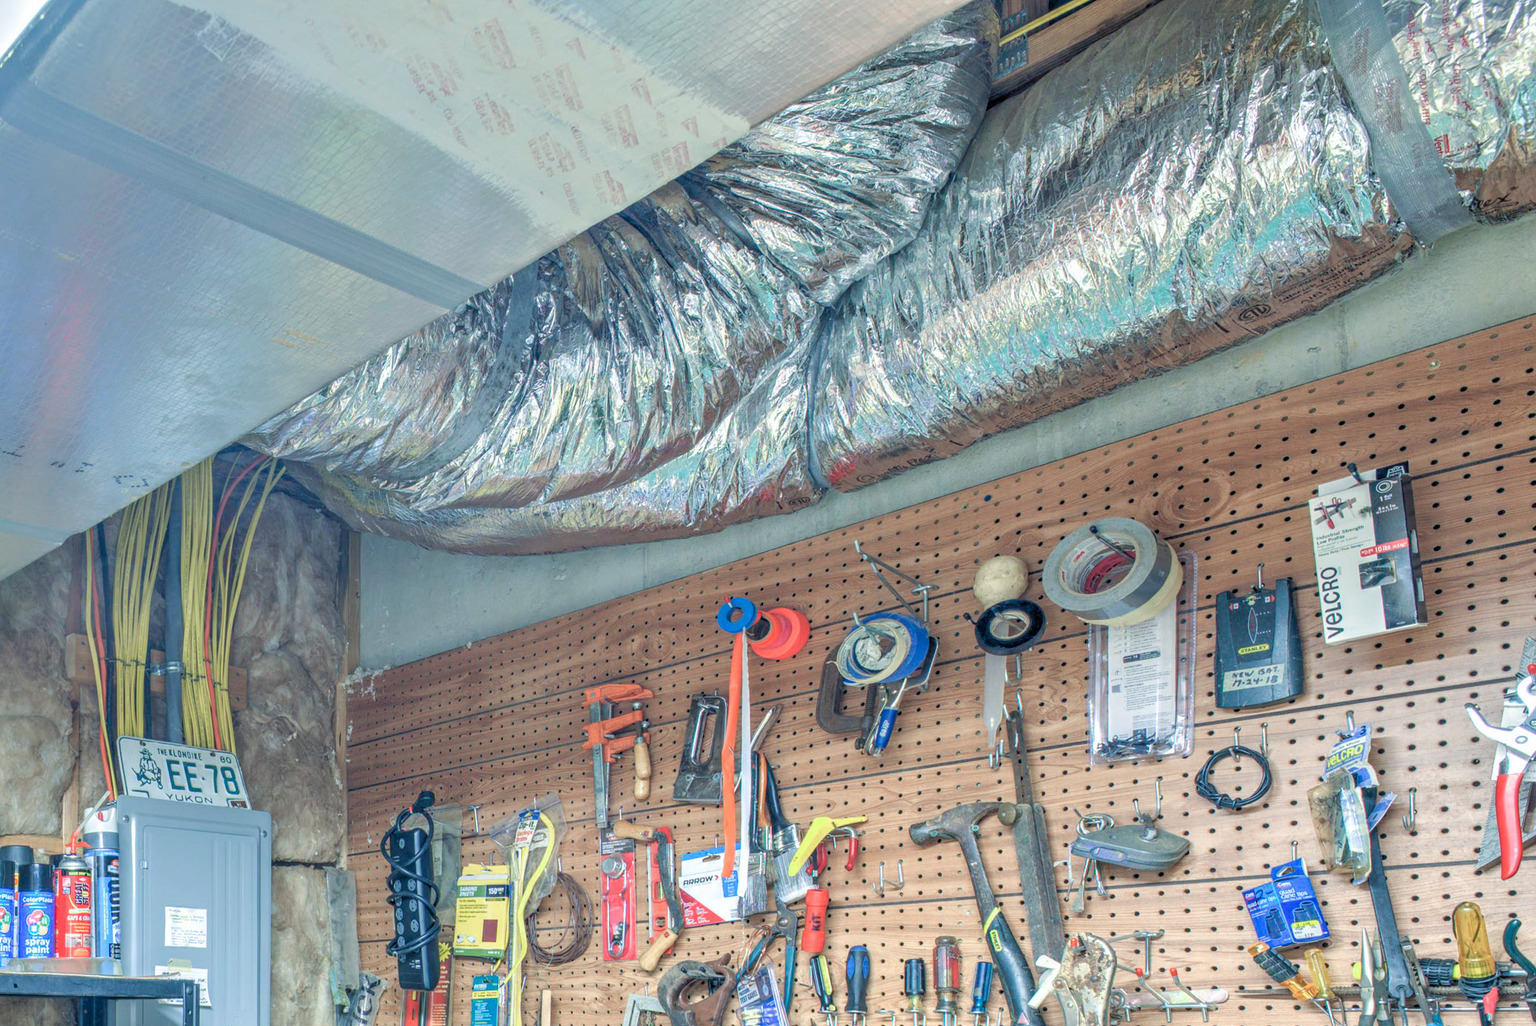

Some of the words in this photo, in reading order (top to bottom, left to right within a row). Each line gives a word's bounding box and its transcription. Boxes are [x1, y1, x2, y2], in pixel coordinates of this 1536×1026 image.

[1316, 530, 1341, 541] Industrial
[1341, 525, 1364, 535] Strength
[1327, 534, 1345, 544] Profile
[1240, 644, 1267, 654] STANLEY
[1232, 670, 1254, 679] NEW
[168, 749, 203, 761] KLONDIKE
[219, 755, 232, 764] 80
[166, 793, 213, 804] YUKON
[683, 874, 714, 887] ARROW
[489, 887, 497, 895] 150
[25, 938, 50, 947] spray
[26, 946, 50, 955] paint
